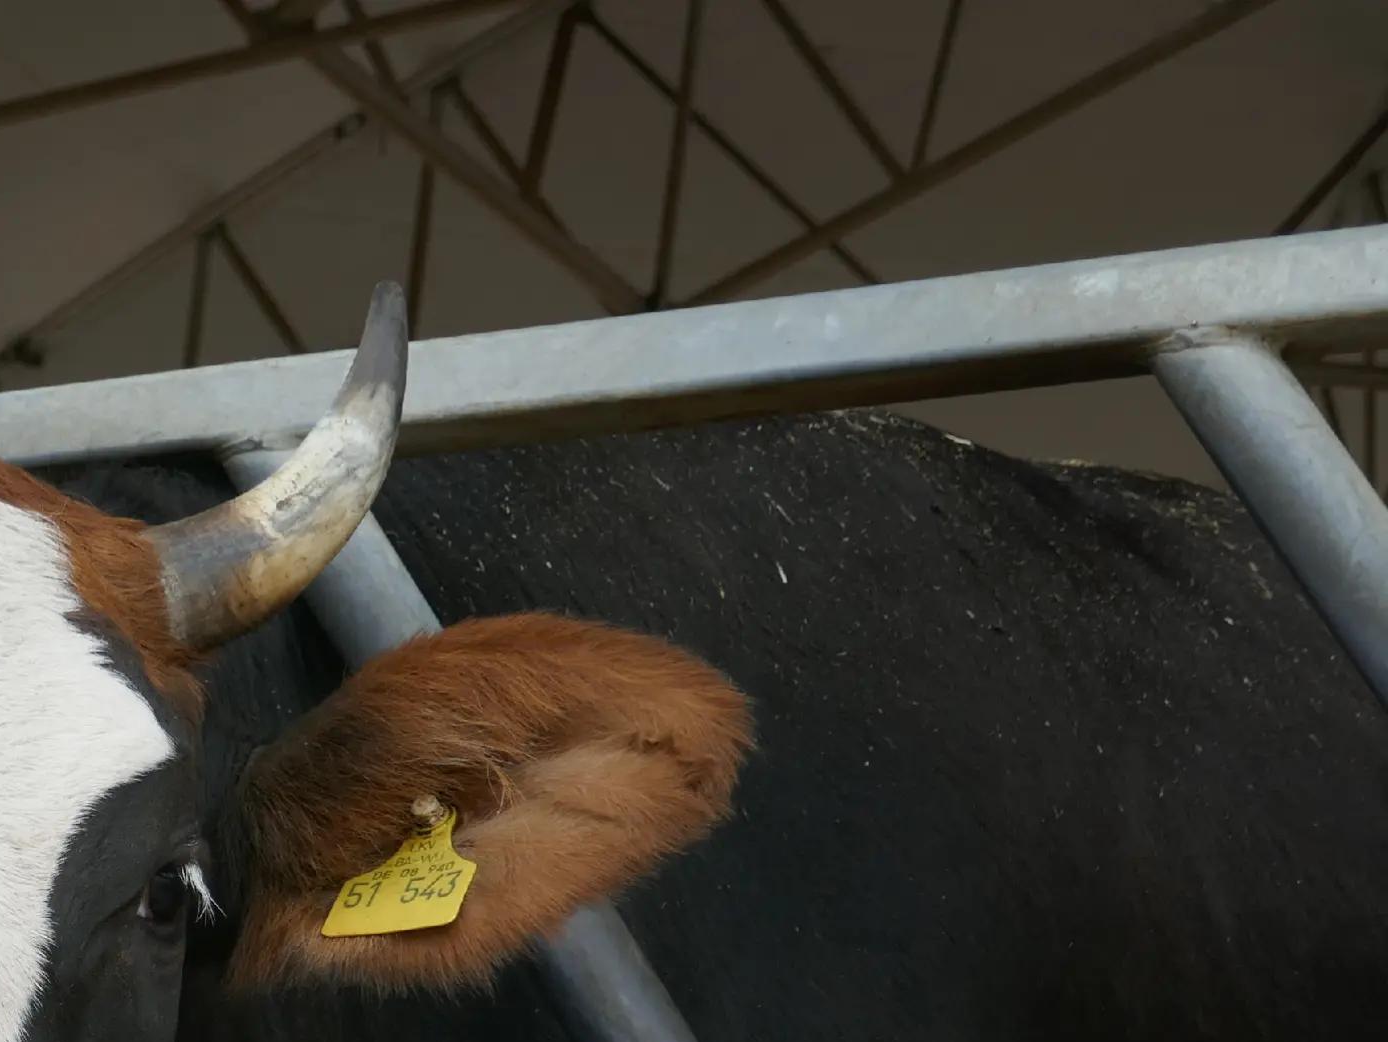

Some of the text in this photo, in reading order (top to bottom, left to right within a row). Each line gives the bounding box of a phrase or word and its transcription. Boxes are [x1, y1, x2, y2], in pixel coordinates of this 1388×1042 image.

[372, 870, 393, 881] DE
[400, 867, 420, 878] 08
[343, 870, 463, 909] 51 543
